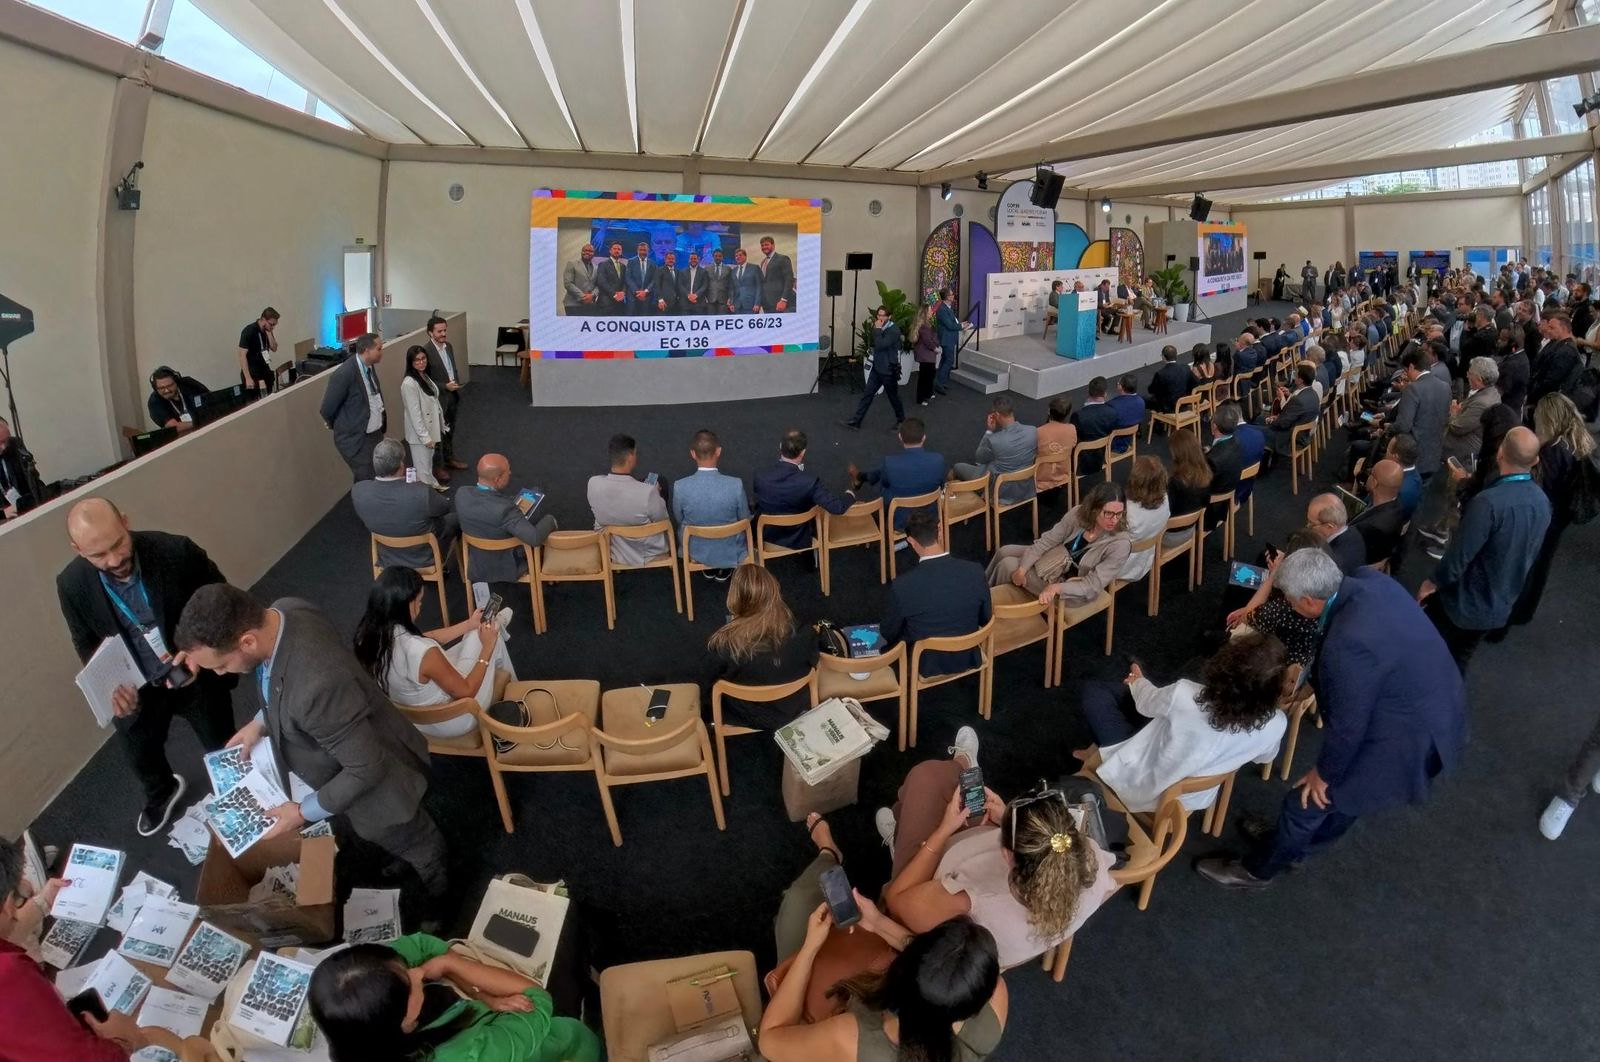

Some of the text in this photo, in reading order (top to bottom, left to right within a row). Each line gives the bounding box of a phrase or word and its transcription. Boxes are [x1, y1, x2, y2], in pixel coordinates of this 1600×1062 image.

[581, 317, 782, 333] A CONQUISTA DA PEC 66/23
[660, 336, 709, 349] EC 136
[499, 908, 538, 925] MANAUS
